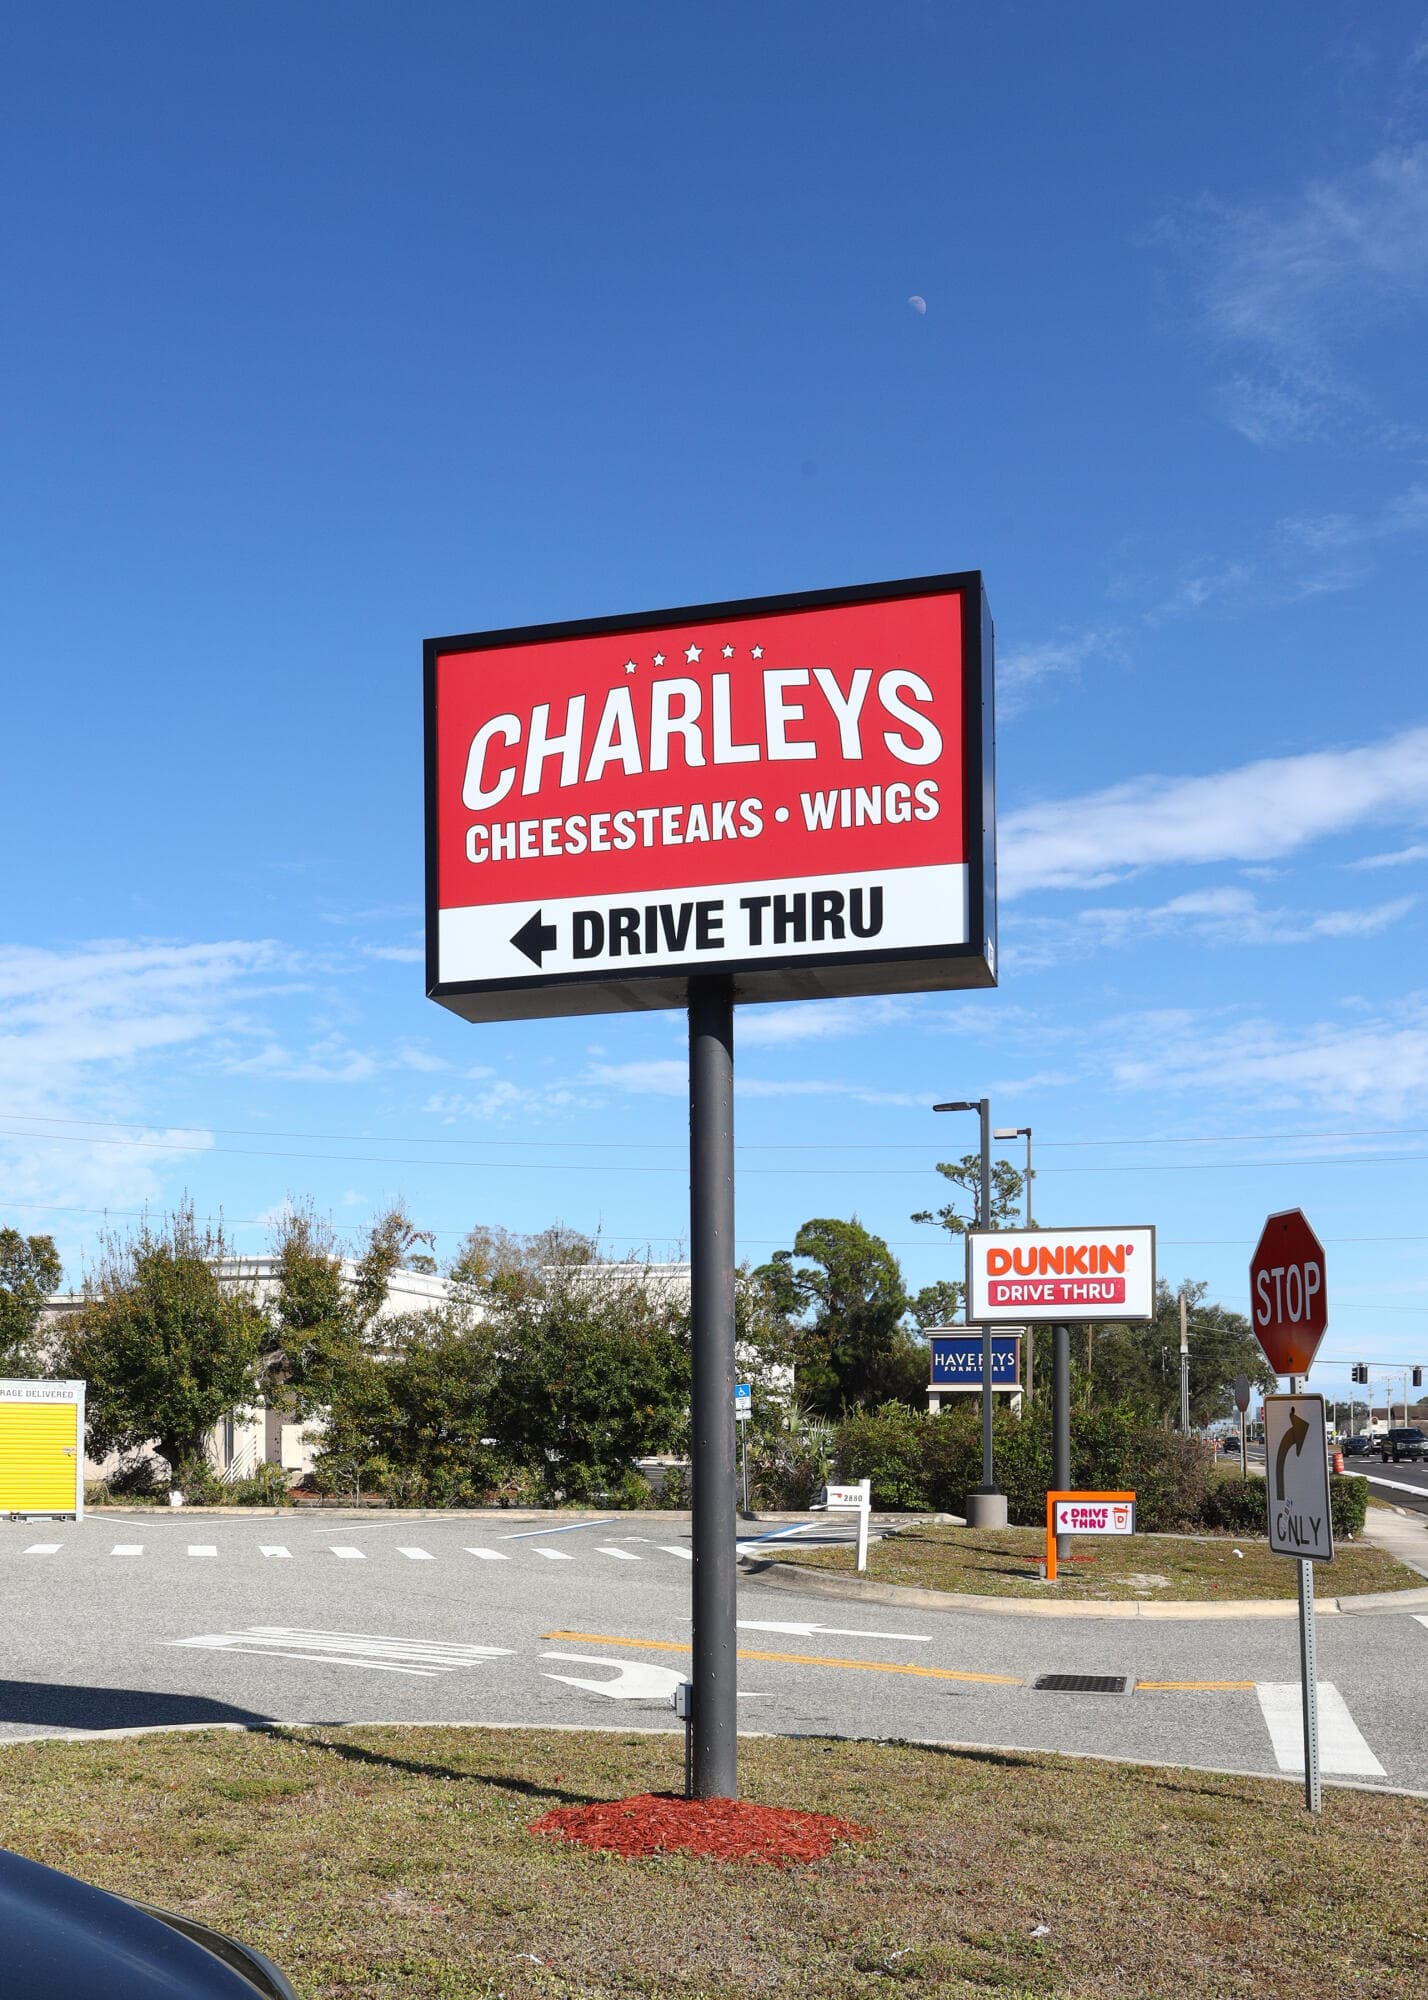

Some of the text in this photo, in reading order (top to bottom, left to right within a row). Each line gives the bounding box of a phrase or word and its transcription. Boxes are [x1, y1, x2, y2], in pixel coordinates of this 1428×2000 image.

[462, 668, 944, 811] CHARLEYS
[466, 779, 940, 864] CHEESESTEAKS WINGS
[572, 886, 884, 960] DRIVE THRU
[986, 1244, 1134, 1277] DUNKIN'
[997, 1282, 1115, 1302] DRIVE THRU
[1256, 1261, 1321, 1327] STOP
[25, 1390, 74, 1399] DELIVERED
[1070, 1508, 1109, 1519] DRIVE
[1071, 1519, 1106, 1529] THRU
[1117, 1516, 1125, 1524] D
